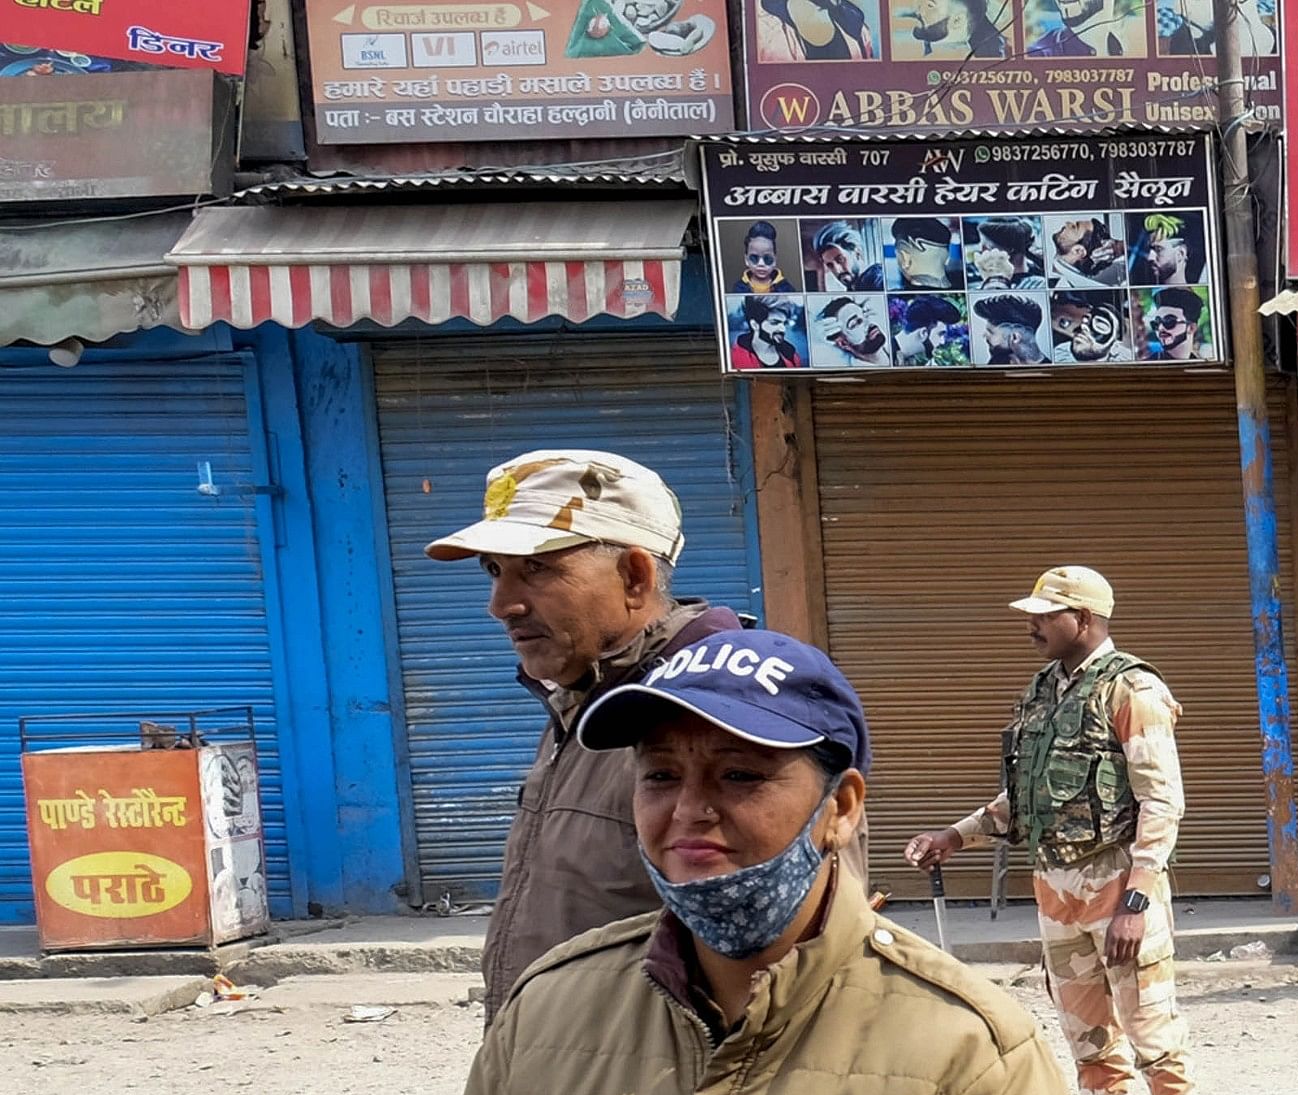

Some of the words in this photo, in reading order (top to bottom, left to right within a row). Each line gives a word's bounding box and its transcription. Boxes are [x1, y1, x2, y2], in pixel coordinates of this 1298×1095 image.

[431, 8, 489, 25] उपलब्ध
[126, 25, 223, 62] डिनर
[360, 50, 385, 61] BSNL
[500, 39, 543, 57] airtel
[323, 76, 386, 100] हमारे
[446, 73, 513, 98] पहाड़ी
[519, 72, 592, 95] मसाले
[598, 73, 684, 92] उपलब्ध
[1046, 69, 1135, 84] 7983037787
[324, 109, 360, 128] पता
[385, 108, 416, 127] बस
[420, 104, 480, 126] स्टेशन
[484, 102, 543, 125] चौराहा
[547, 99, 617, 126] हल्द्वानी
[623, 98, 717, 126] (नैनीताल)
[823, 88, 975, 126] ABBAS
[985, 87, 1137, 125] WARSI
[1145, 101, 1217, 122] Unisex
[719, 149, 744, 169] प्रो.
[749, 150, 795, 172] यूसुफ
[859, 150, 890, 167] 707
[992, 144, 1095, 163] 9837256770,
[1099, 140, 1196, 159] 7983037787
[723, 184, 832, 206] अब्बास
[838, 176, 928, 204] वारसी
[933, 177, 1000, 205] हेयर
[1006, 173, 1099, 201] कटिंग
[1113, 170, 1195, 205] सैलून
[645, 644, 795, 696] POLICE
[37, 788, 97, 830] पाण्डे
[70, 863, 167, 905] पराठे
